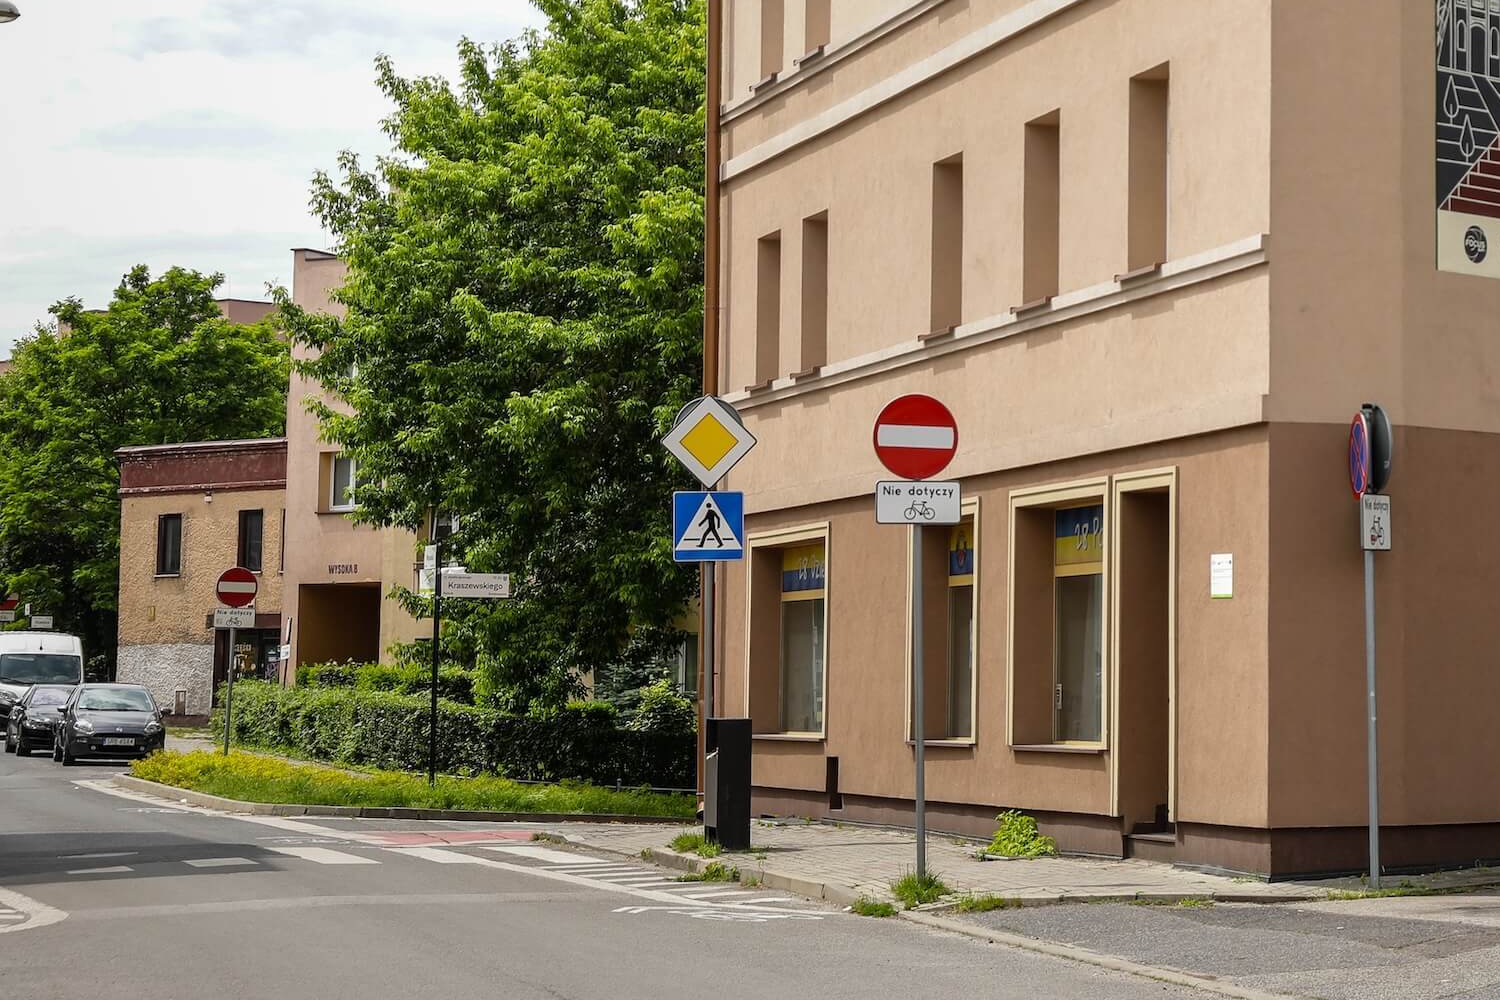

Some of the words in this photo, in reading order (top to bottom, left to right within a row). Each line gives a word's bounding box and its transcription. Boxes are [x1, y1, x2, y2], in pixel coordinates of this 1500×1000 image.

[883, 486, 901, 496] Nie
[908, 486, 954, 499] dotyczy
[448, 581, 503, 592] Kraszewskiego
